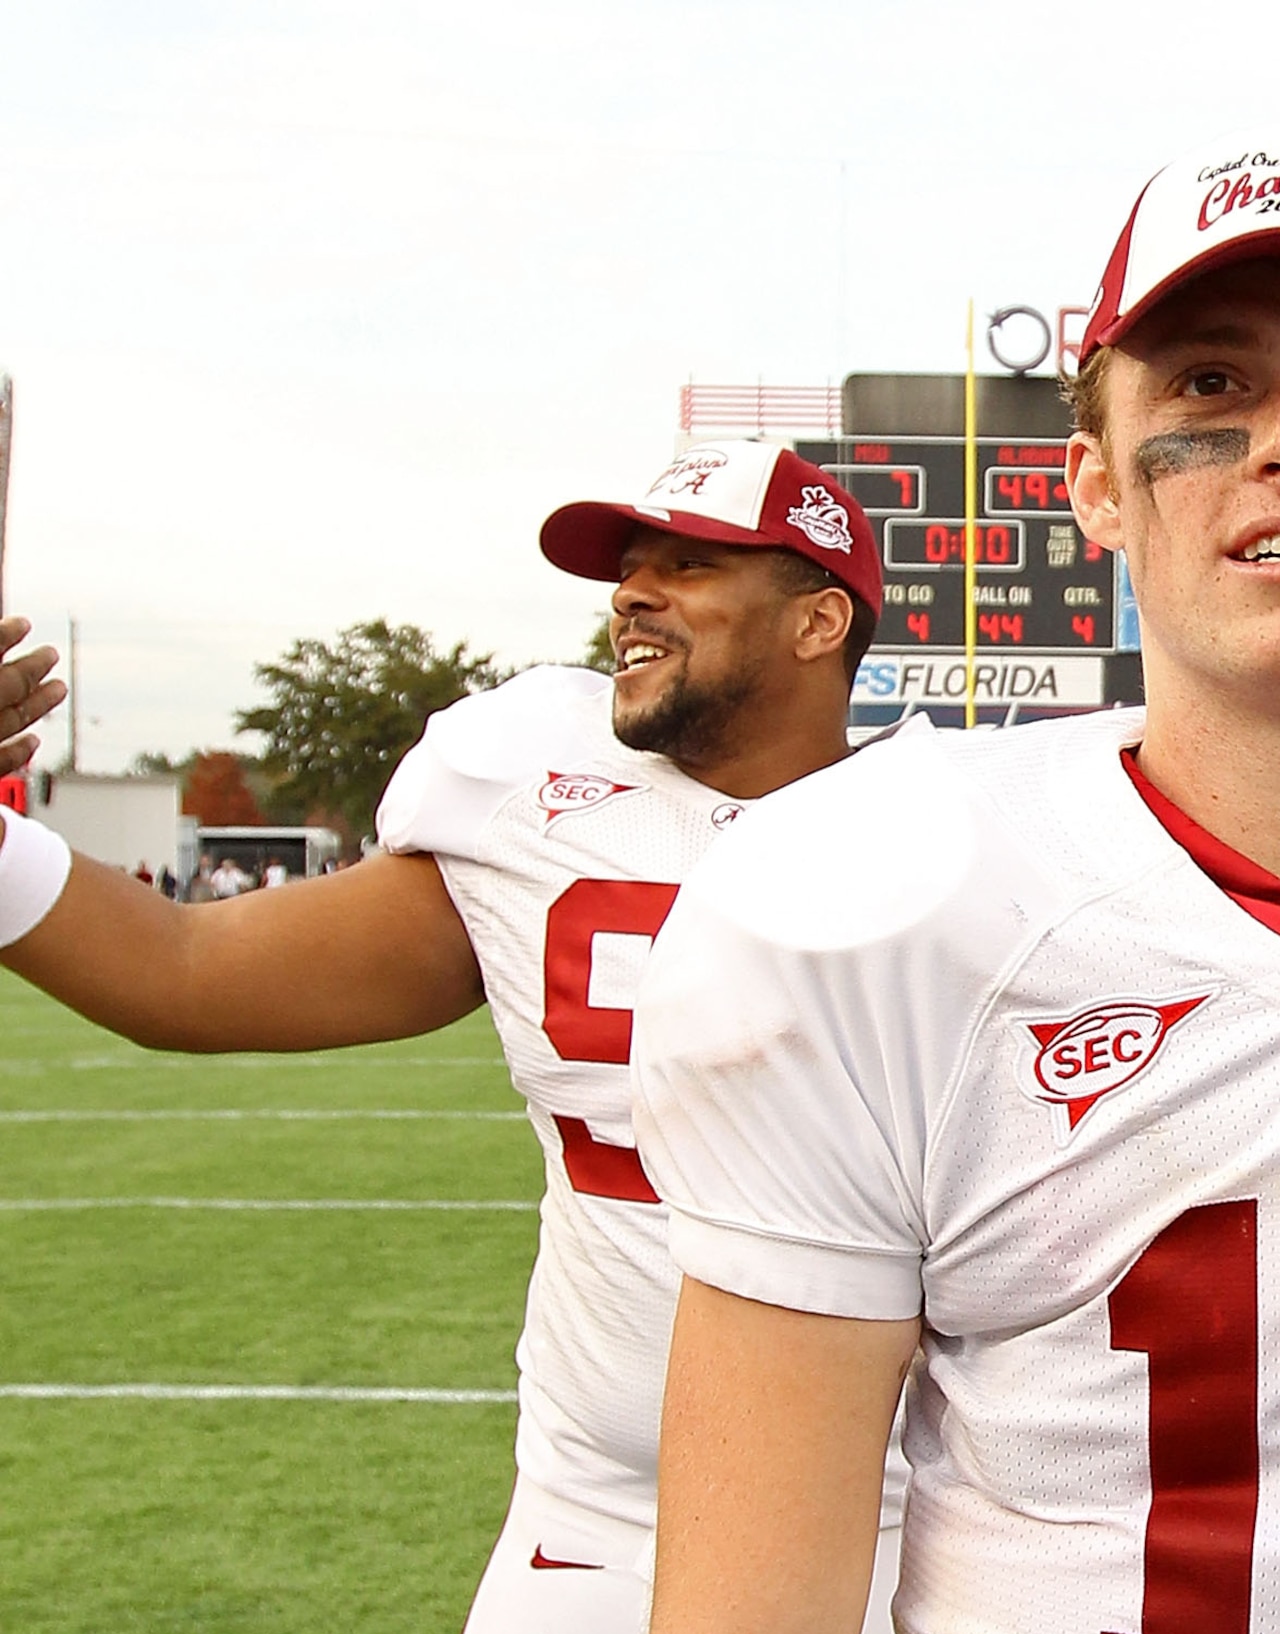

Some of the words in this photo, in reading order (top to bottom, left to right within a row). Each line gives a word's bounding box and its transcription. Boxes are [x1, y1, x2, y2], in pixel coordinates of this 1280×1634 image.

[1252, 152, 1280, 167] One
[998, 473, 1049, 508] 49
[883, 585, 904, 606] TO
[908, 585, 935, 606] GO
[907, 613, 931, 643] 4
[979, 614, 1024, 644] 44
[1072, 614, 1096, 644] 4
[550, 783, 600, 801] SEC
[1052, 1029, 1143, 1079] SEC
